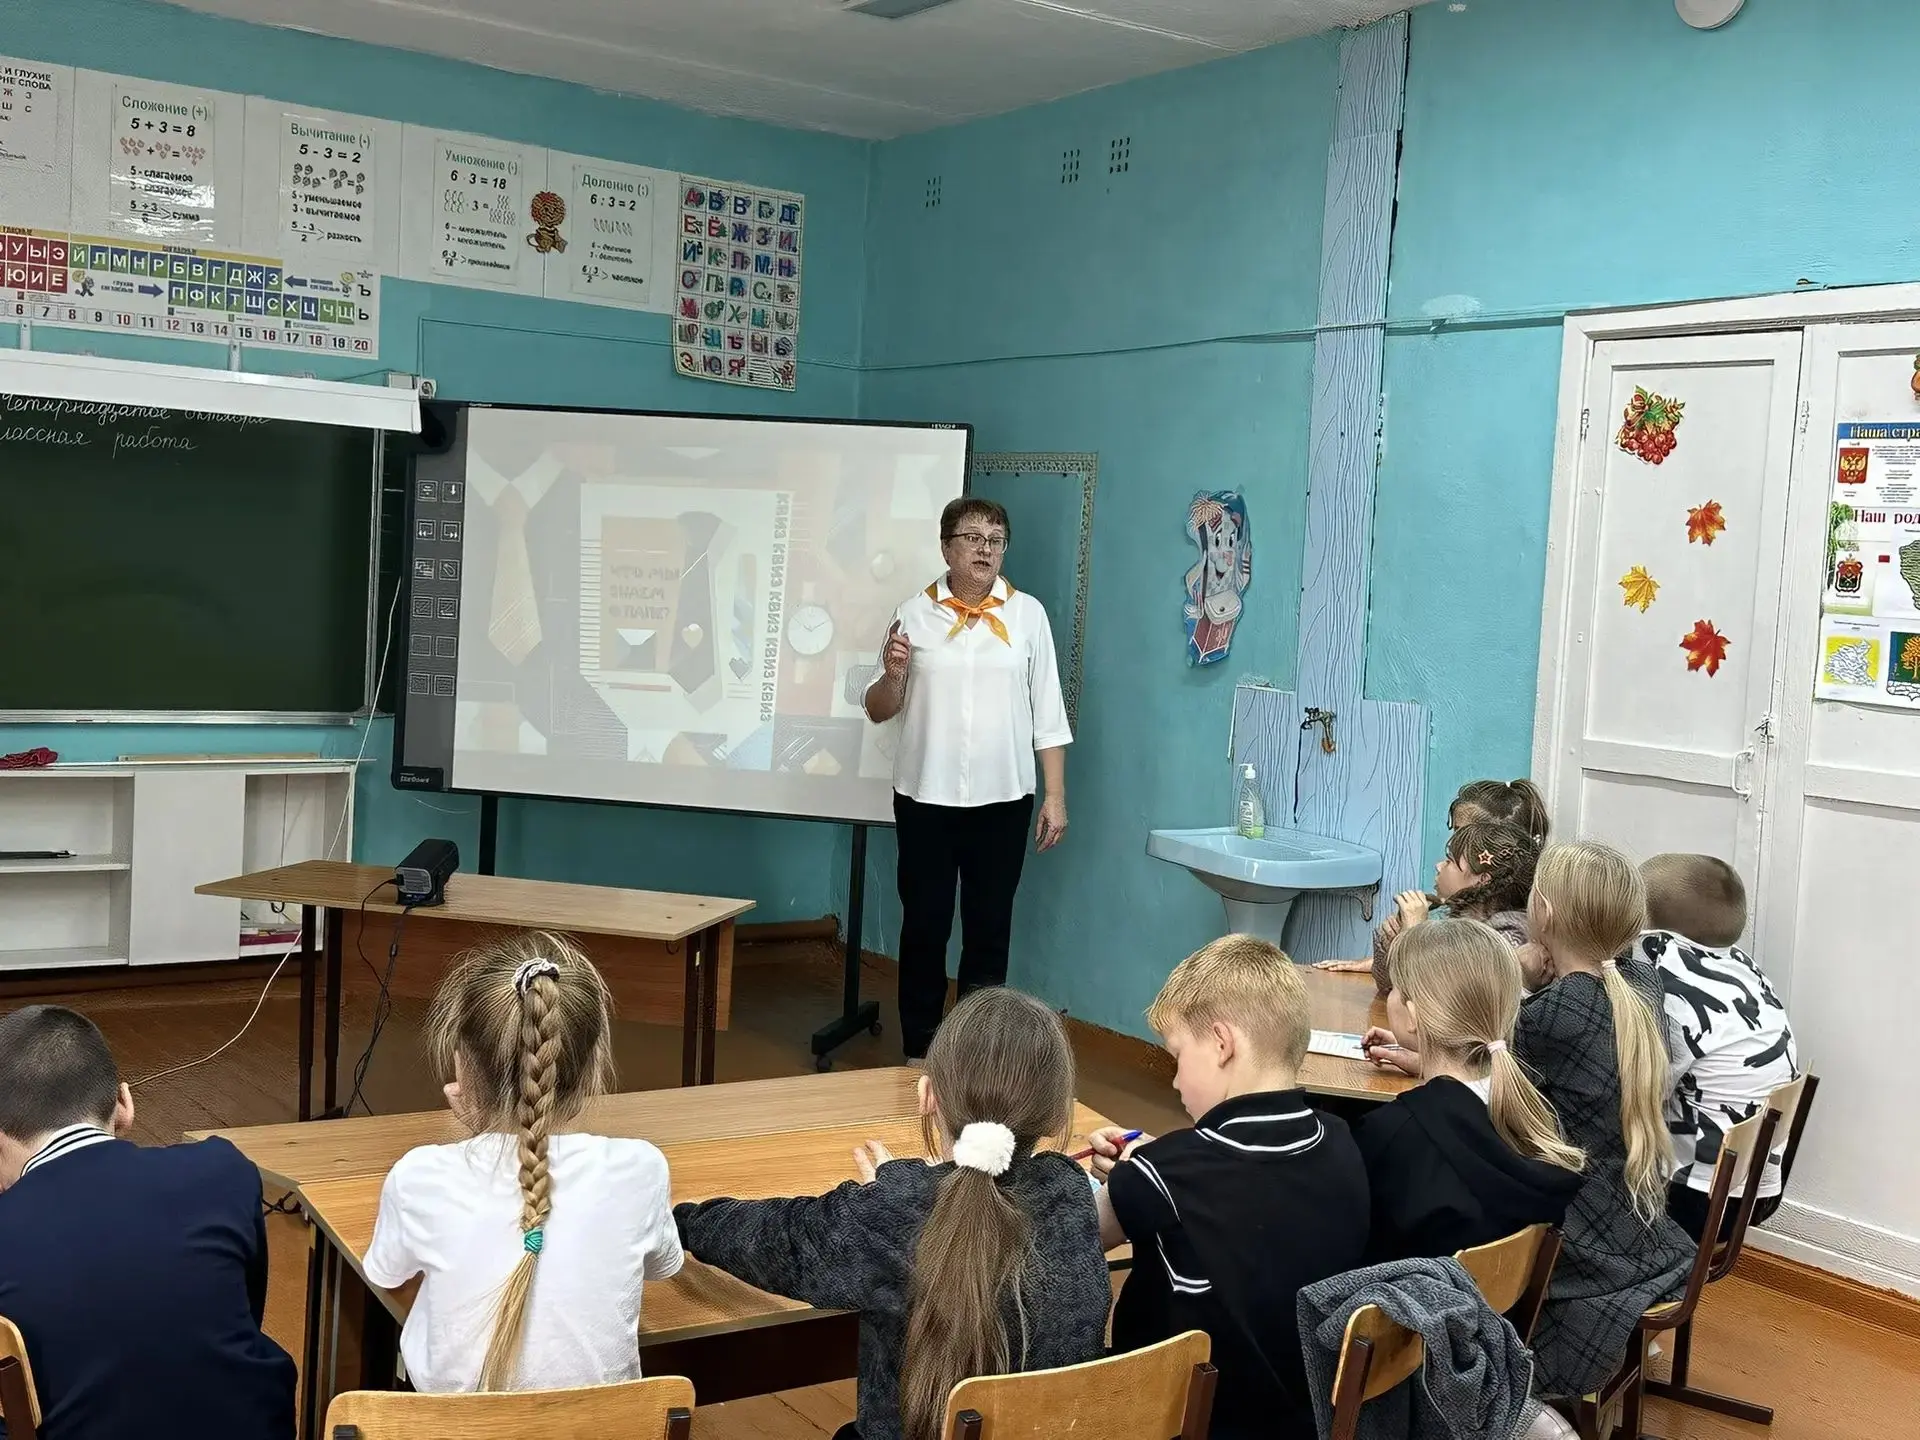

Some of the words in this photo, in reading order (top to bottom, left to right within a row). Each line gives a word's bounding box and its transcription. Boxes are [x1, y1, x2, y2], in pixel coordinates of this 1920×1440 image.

[5, 67, 12, 75] И
[15, 69, 52, 82] ГЛУХИЕ
[3, 88, 13, 96] Ж
[19, 79, 52, 90] СЛОВА
[2, 102, 12, 110] Ш
[122, 95, 188, 116] Сложение
[192, 106, 208, 121] (+)
[130, 118, 140, 130] 5
[159, 122, 168, 133] 3
[186, 125, 196, 137] 8
[291, 123, 356, 144] Вычитание
[299, 144, 308, 154] 5
[324, 147, 333, 158] 3
[352, 152, 362, 163] 2
[445, 148, 505, 170] Умножение
[131, 166, 136, 175] 5
[144, 169, 192, 182] слагаемое
[450, 170, 458, 181] 6
[469, 173, 476, 184] 3
[492, 178, 507, 190] 18
[582, 174, 634, 193] Деление
[292, 191, 297, 199] 5
[304, 193, 362, 208] уменьшаемое
[590, 194, 597, 204] 6
[608, 197, 615, 208] 3
[629, 200, 636, 211] 2
[292, 204, 298, 212] 3
[306, 208, 360, 222] вычитаемое
[734, 196, 746, 215] В
[780, 204, 796, 225] Д
[301, 234, 307, 242] 2
[327, 231, 362, 243] разность
[684, 214, 696, 233] Е
[708, 216, 720, 237] Ё
[732, 223, 748, 243] Ж
[756, 227, 769, 245] З
[780, 230, 792, 248] И
[12, 241, 23, 255] У
[30, 244, 46, 259] Ы
[52, 248, 65, 260] Э
[73, 245, 85, 260] Й
[94, 253, 106, 264] Л
[113, 255, 126, 268] М
[134, 258, 144, 270] Н
[154, 259, 164, 272] Р
[174, 262, 184, 274] Б
[192, 264, 204, 276] В
[212, 266, 222, 278] Г
[229, 269, 242, 284] Д
[247, 270, 262, 284] Ж
[268, 273, 278, 285] З
[683, 240, 697, 262] Й
[731, 251, 744, 270] Л
[755, 254, 771, 275] М
[778, 258, 793, 277] Н
[8, 268, 26, 282] Ю
[32, 271, 43, 284] И
[52, 273, 63, 286] Е
[172, 286, 183, 299] П
[190, 288, 204, 302] Ф
[211, 291, 221, 304] К
[231, 294, 242, 305] Т
[246, 296, 262, 309] Ш
[267, 298, 278, 310] С
[286, 300, 297, 312] Х
[304, 302, 316, 317] Ц
[323, 304, 333, 316] Ч
[338, 305, 354, 321] Щ
[357, 284, 371, 296] Ъ
[682, 270, 696, 289] О
[706, 274, 720, 292] П
[754, 282, 767, 300] С
[359, 308, 369, 320] Ь
[728, 304, 742, 323] Х
[16, 304, 23, 314] 6
[42, 306, 50, 316] 7
[69, 308, 76, 320] 8
[95, 311, 102, 322] 9
[117, 314, 130, 325] 10
[141, 316, 154, 328] 11
[166, 319, 179, 330] 12
[190, 322, 204, 333] 13
[215, 324, 228, 336] 14
[239, 327, 252, 338] 15
[263, 329, 276, 341] 16
[286, 332, 300, 344] 17
[309, 335, 322, 346] 18
[332, 337, 345, 349] 19
[354, 340, 368, 351] 20
[728, 336, 744, 350] Ъ
[751, 335, 768, 353] Ы
[703, 355, 722, 375] Ю
[728, 359, 743, 376] Я
[1850, 426, 1887, 439] Наша
[0, 426, 92, 445] лассная
[112, 425, 200, 460] работа
[774, 493, 790, 539] КВИЗ
[1854, 509, 1886, 523] Наш
[770, 544, 786, 588] КВИЗ
[767, 591, 782, 634] КВИЗ
[763, 638, 778, 679] КВИЗ
[760, 682, 775, 722] КВИЗ
